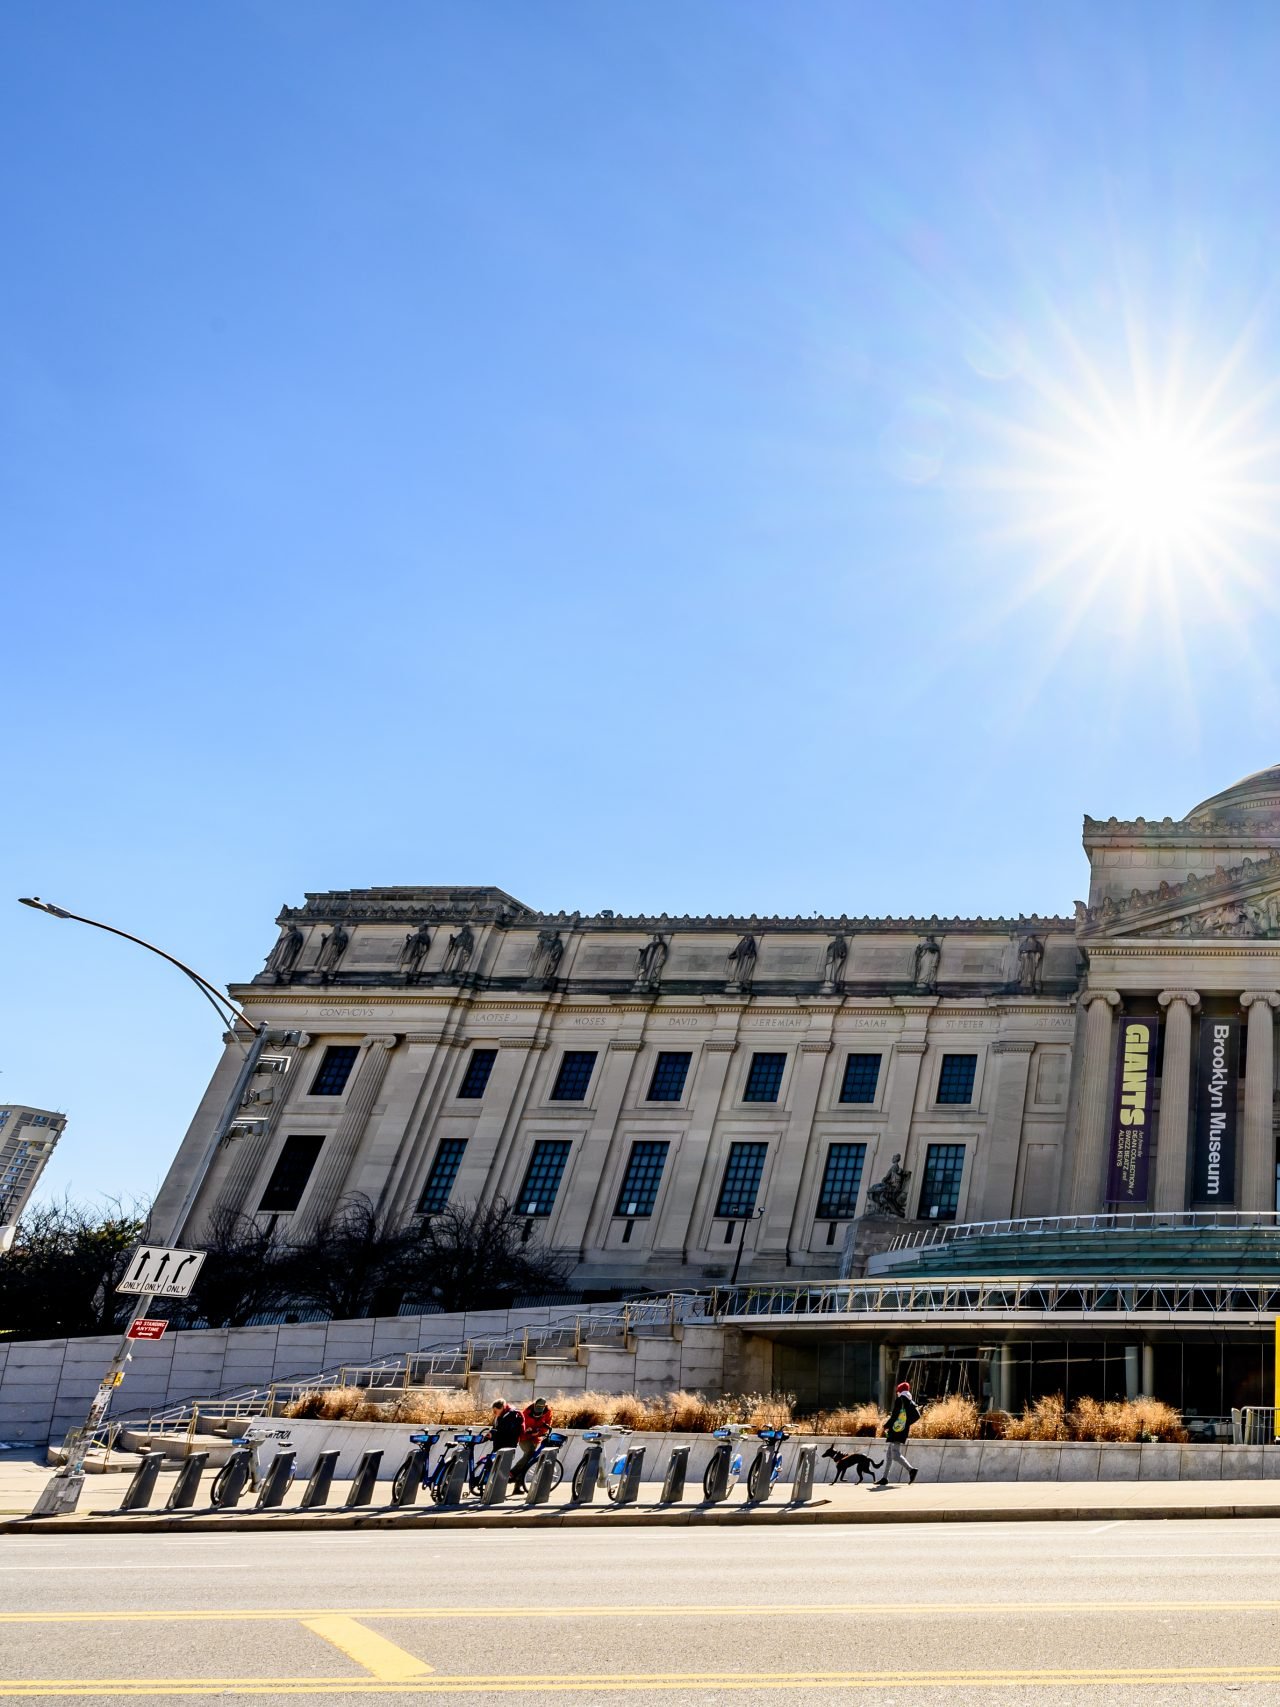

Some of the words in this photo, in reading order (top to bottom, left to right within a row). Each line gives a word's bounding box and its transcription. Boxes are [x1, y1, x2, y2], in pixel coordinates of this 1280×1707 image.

[574, 1017, 607, 1026] MOSES
[668, 1017, 698, 1026] DAVID
[854, 1019, 888, 1029] ISAIAH
[1207, 1024, 1230, 1108] Brooklyn
[1120, 1024, 1150, 1126] GIANTS
[1116, 1150, 1124, 1167] KEYS
[1206, 1112, 1227, 1195] Museum
[1129, 1148, 1137, 1189] COLLECTION
[123, 1281, 142, 1290] ONLY
[144, 1283, 162, 1291] ONLY
[166, 1285, 187, 1293] ONLY
